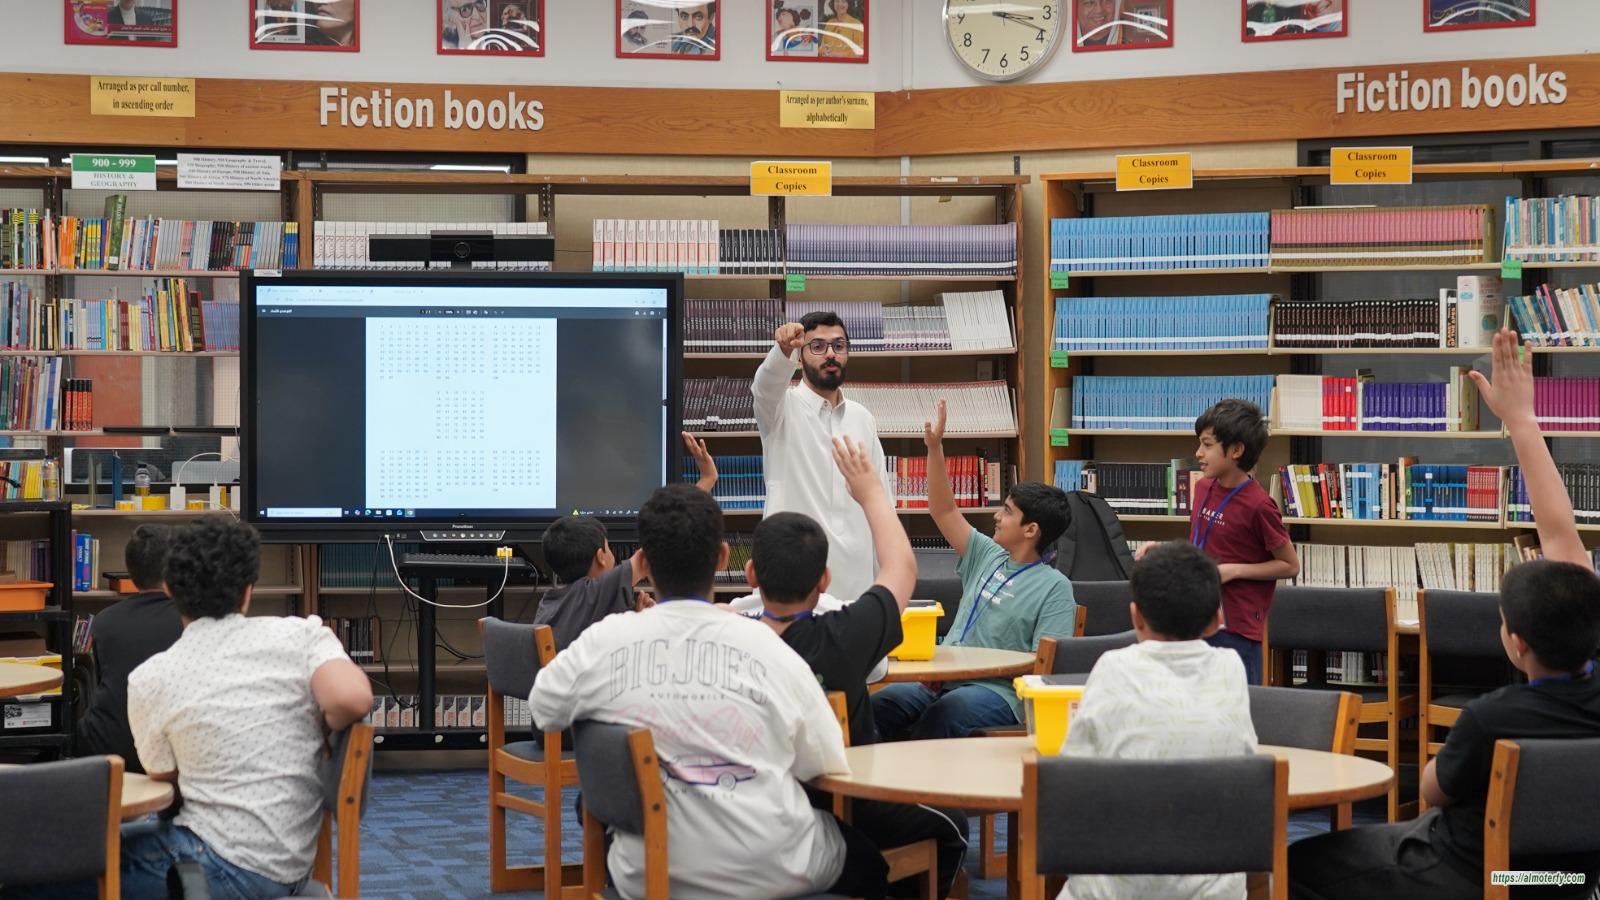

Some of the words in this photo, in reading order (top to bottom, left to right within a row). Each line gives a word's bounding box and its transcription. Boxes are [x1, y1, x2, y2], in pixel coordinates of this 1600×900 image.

[1042, 6, 1052, 20] 3
[963, 33, 972, 47] 8
[1036, 30, 1045, 43] 4
[981, 49, 990, 63] 7
[1020, 46, 1029, 61] 5
[1000, 53, 1009, 68] 6
[98, 81, 127, 93] Arranged
[129, 84, 137, 92] as
[138, 83, 148, 94] per
[150, 82, 162, 92] call
[163, 83, 190, 93] number,
[1336, 70, 1451, 114] Fiction
[1461, 62, 1568, 108] books
[113, 99, 120, 109] in
[121, 100, 153, 112] ascending
[155, 101, 174, 110] order
[786, 94, 809, 106] Arranged
[816, 96, 825, 107] per
[826, 95, 846, 105] author's
[847, 96, 869, 106] surname,
[320, 87, 433, 128] Fiction
[444, 90, 545, 131] books
[806, 112, 848, 125] alphabetically
[1131, 156, 1179, 169] Classroom
[1347, 150, 1398, 162] Classroom
[92, 159, 110, 167] 900
[119, 159, 136, 167] 999
[768, 164, 817, 176] Classroom
[1355, 167, 1387, 180] Copies
[1138, 172, 1169, 185] Copies
[775, 180, 807, 193] Copies
[609, 639, 669, 702] BIG
[673, 638, 768, 705] JOE'S
[650, 692, 726, 701] AUTOMOBILE
